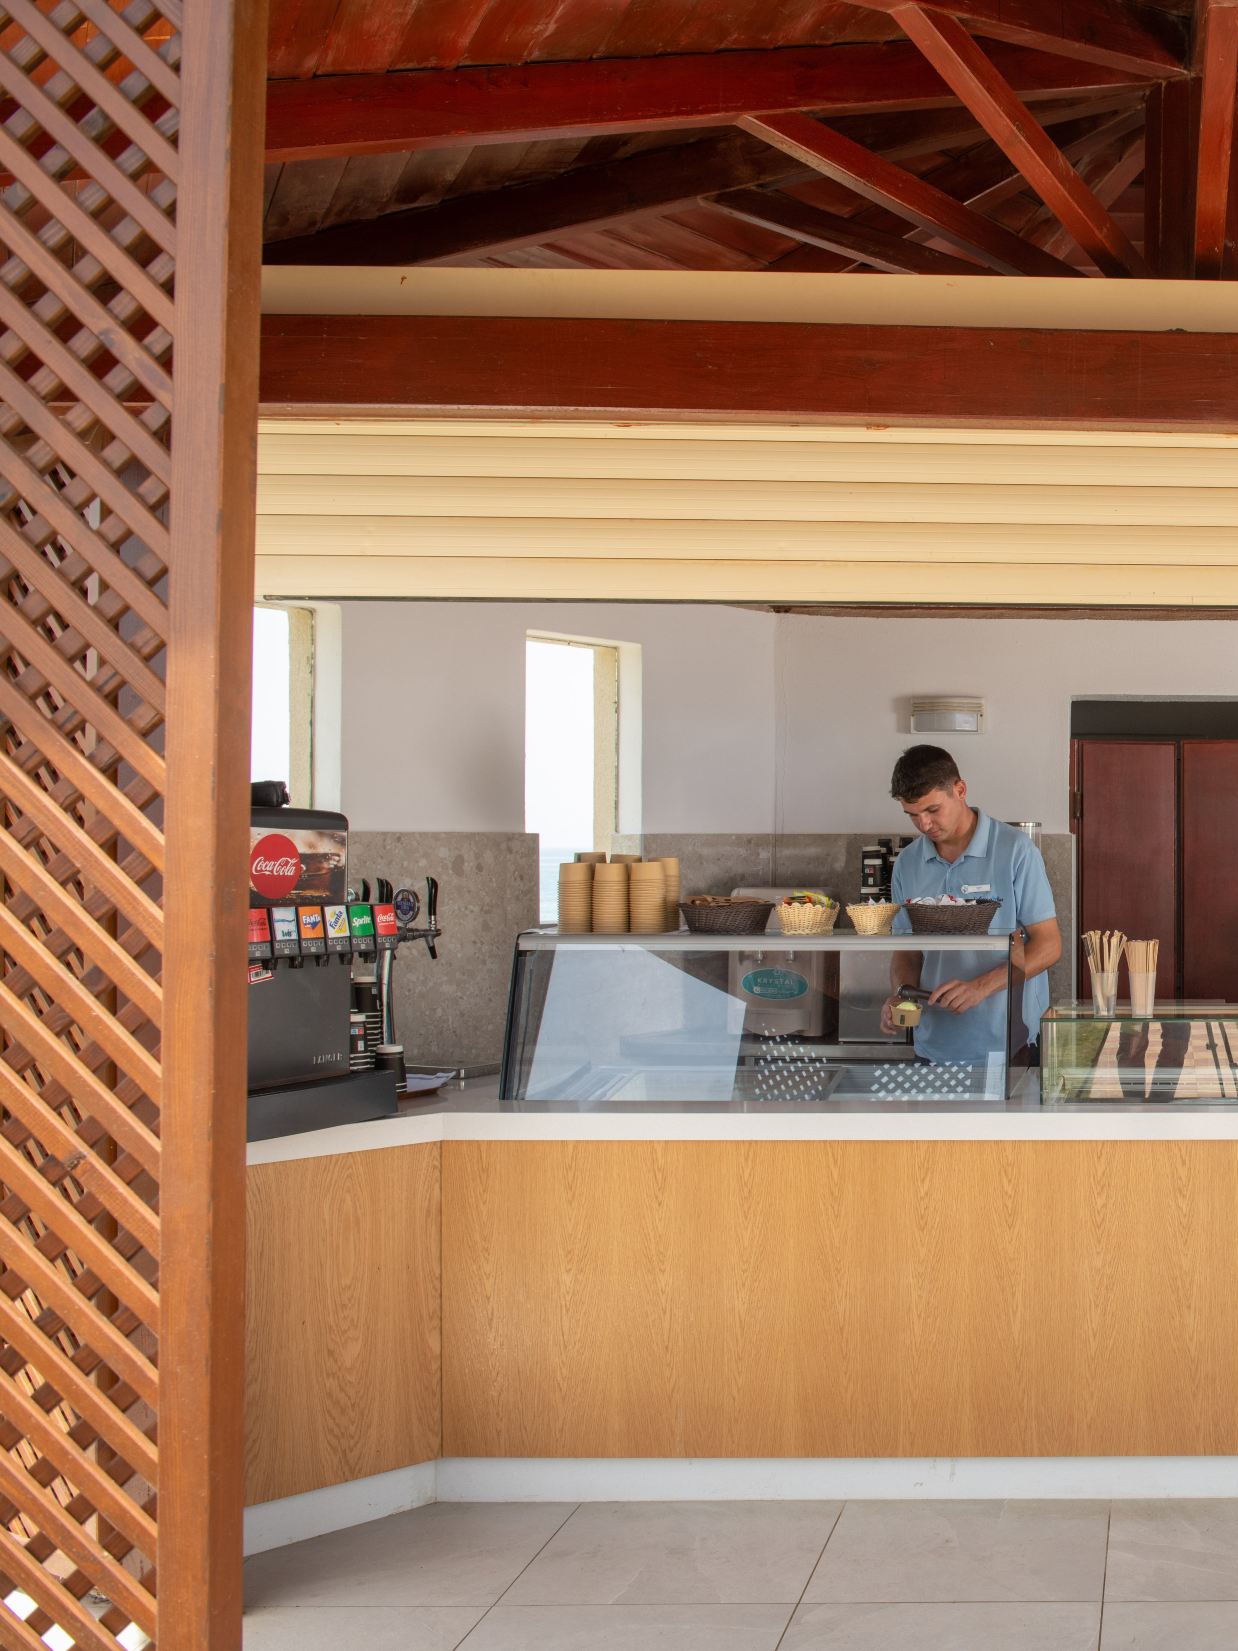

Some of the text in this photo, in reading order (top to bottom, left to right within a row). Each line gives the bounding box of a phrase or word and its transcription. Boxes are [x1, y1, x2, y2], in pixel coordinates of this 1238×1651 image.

[252, 856, 299, 876] Coca-Cola
[329, 910, 343, 930] Fanta
[352, 915, 371, 927] Sprite
